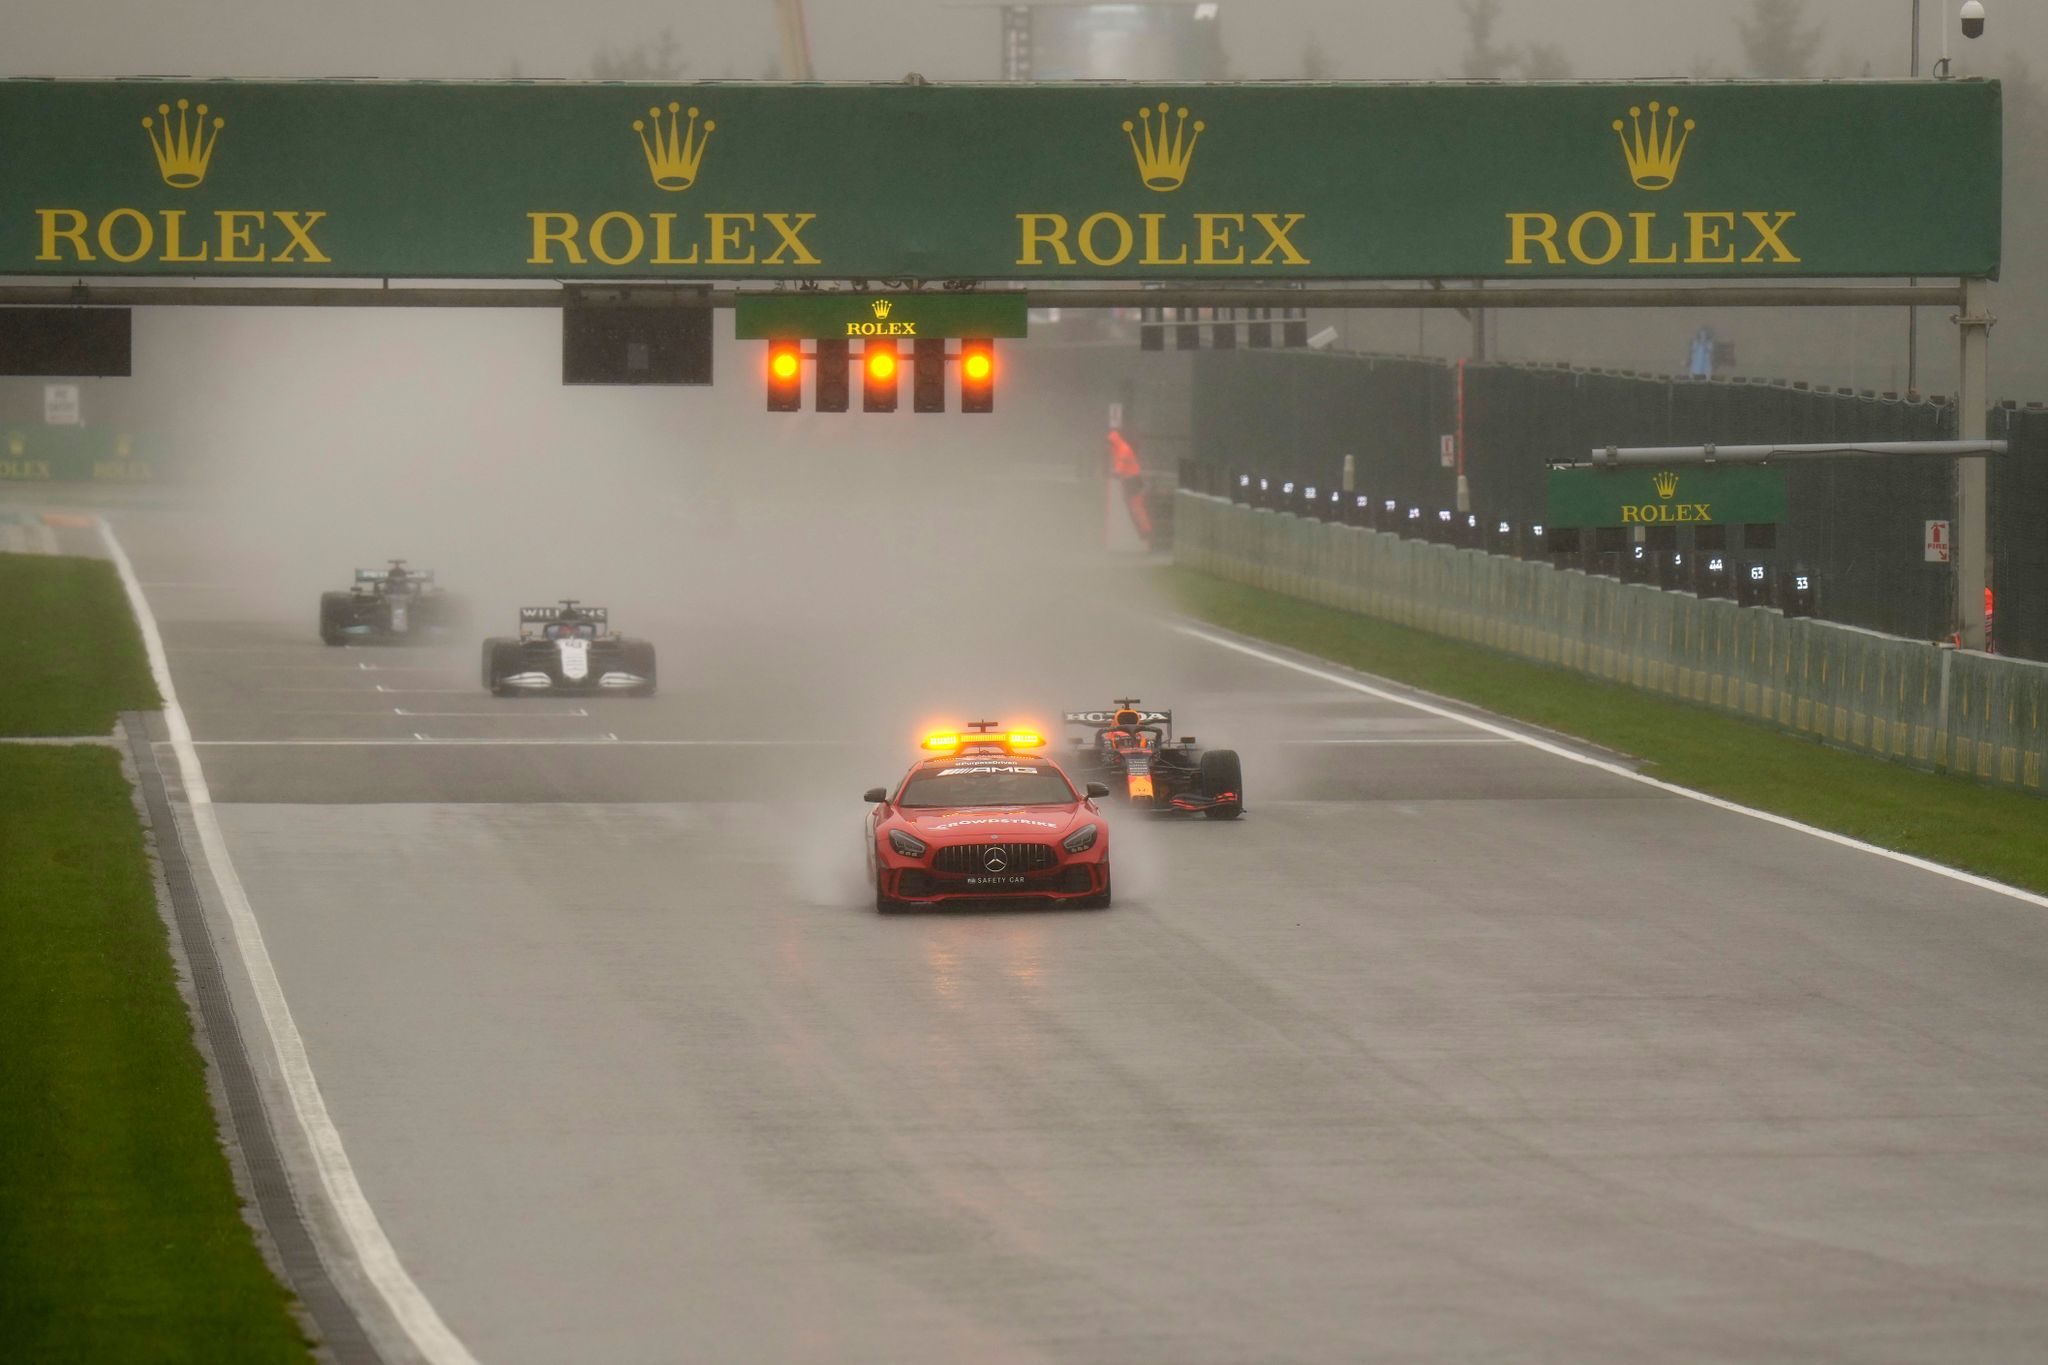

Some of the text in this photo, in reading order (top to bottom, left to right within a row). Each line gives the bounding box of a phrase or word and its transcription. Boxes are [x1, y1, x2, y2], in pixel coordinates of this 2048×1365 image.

[36, 207, 331, 264] ROLEX
[527, 211, 823, 267] ROLEX
[1015, 211, 1311, 268] ROLEX
[1505, 210, 1802, 267] ROLEX
[845, 321, 918, 338] ROLEX
[1621, 503, 1712, 523] ROLEX
[1709, 559, 1722, 571] 44
[1751, 566, 1764, 580] 63
[1796, 576, 1809, 590] 33
[1066, 712, 1169, 722] HODA
[968, 766, 1038, 775] AMG
[929, 818, 1057, 831] CROWDSTRIKE
[978, 876, 1006, 884] SAFETY
[1009, 876, 1025, 884] CAR
